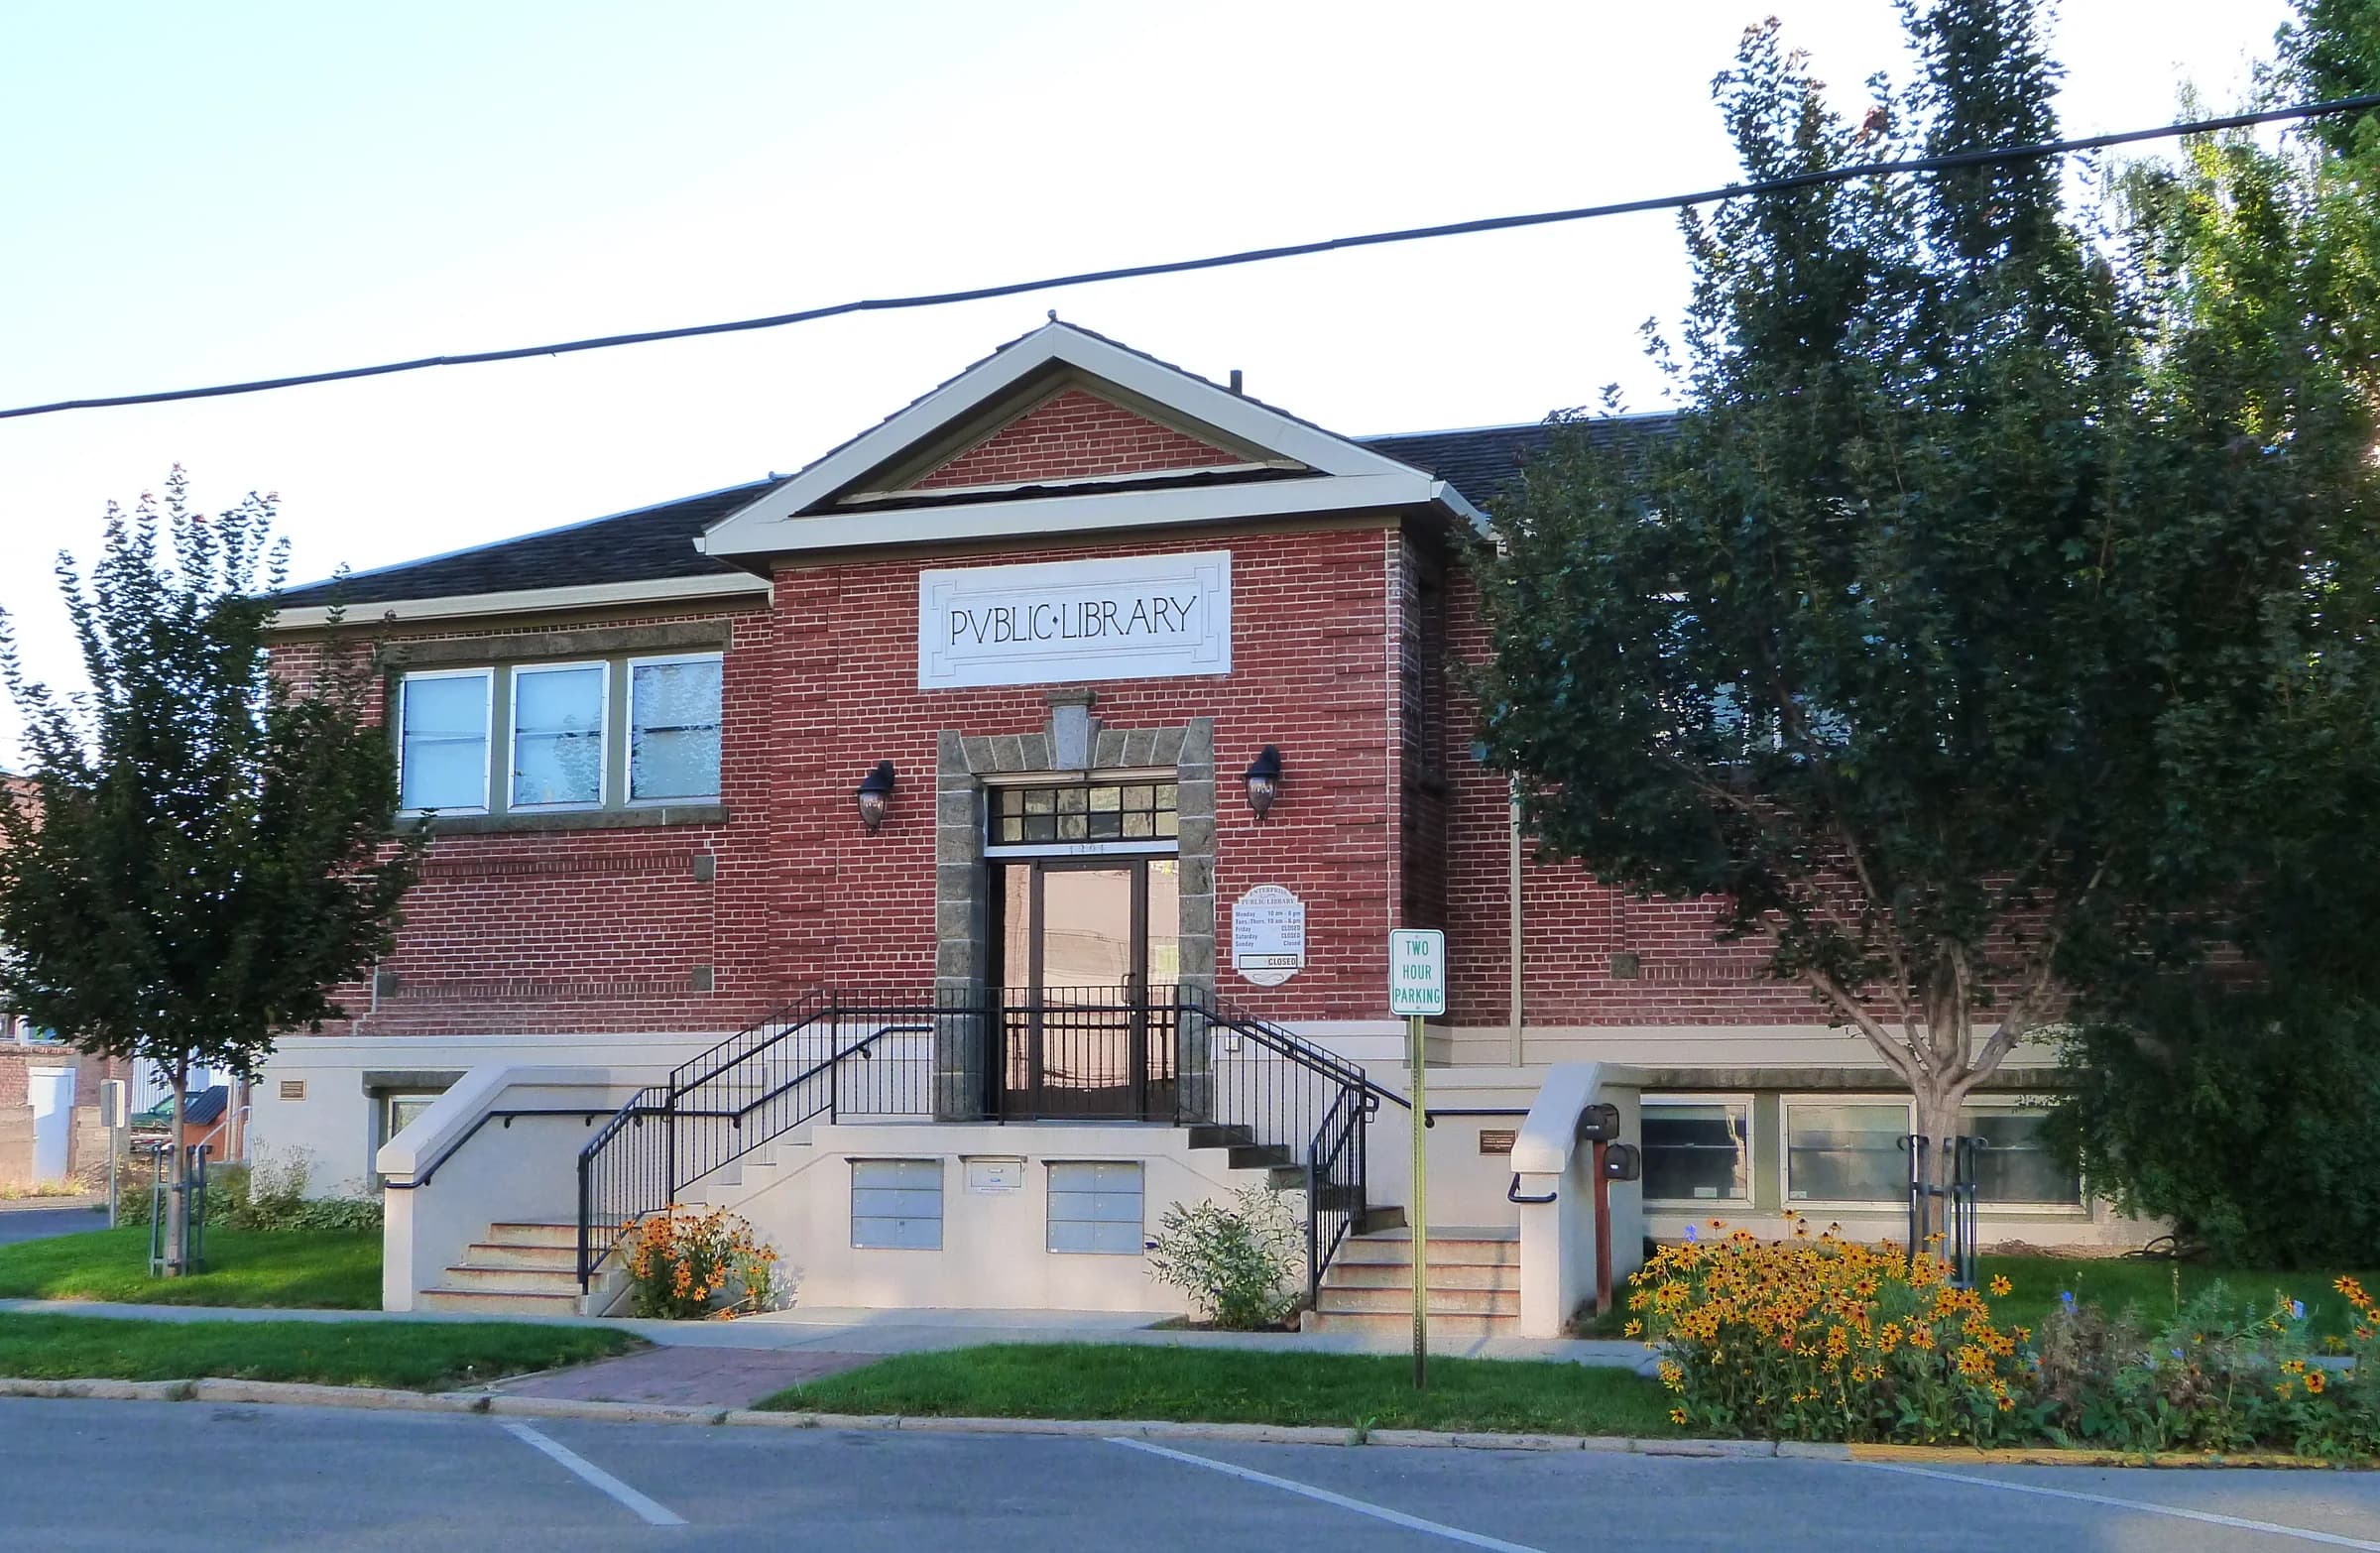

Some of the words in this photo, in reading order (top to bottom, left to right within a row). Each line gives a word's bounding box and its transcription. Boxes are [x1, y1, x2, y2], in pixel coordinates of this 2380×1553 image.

[1061, 595, 1198, 640] LIBRARY
[1405, 941, 1429, 956] TWO
[1268, 957, 1296, 966] CLOSED
[1403, 965, 1431, 980] HOUR
[1394, 988, 1440, 1004] PARKING
